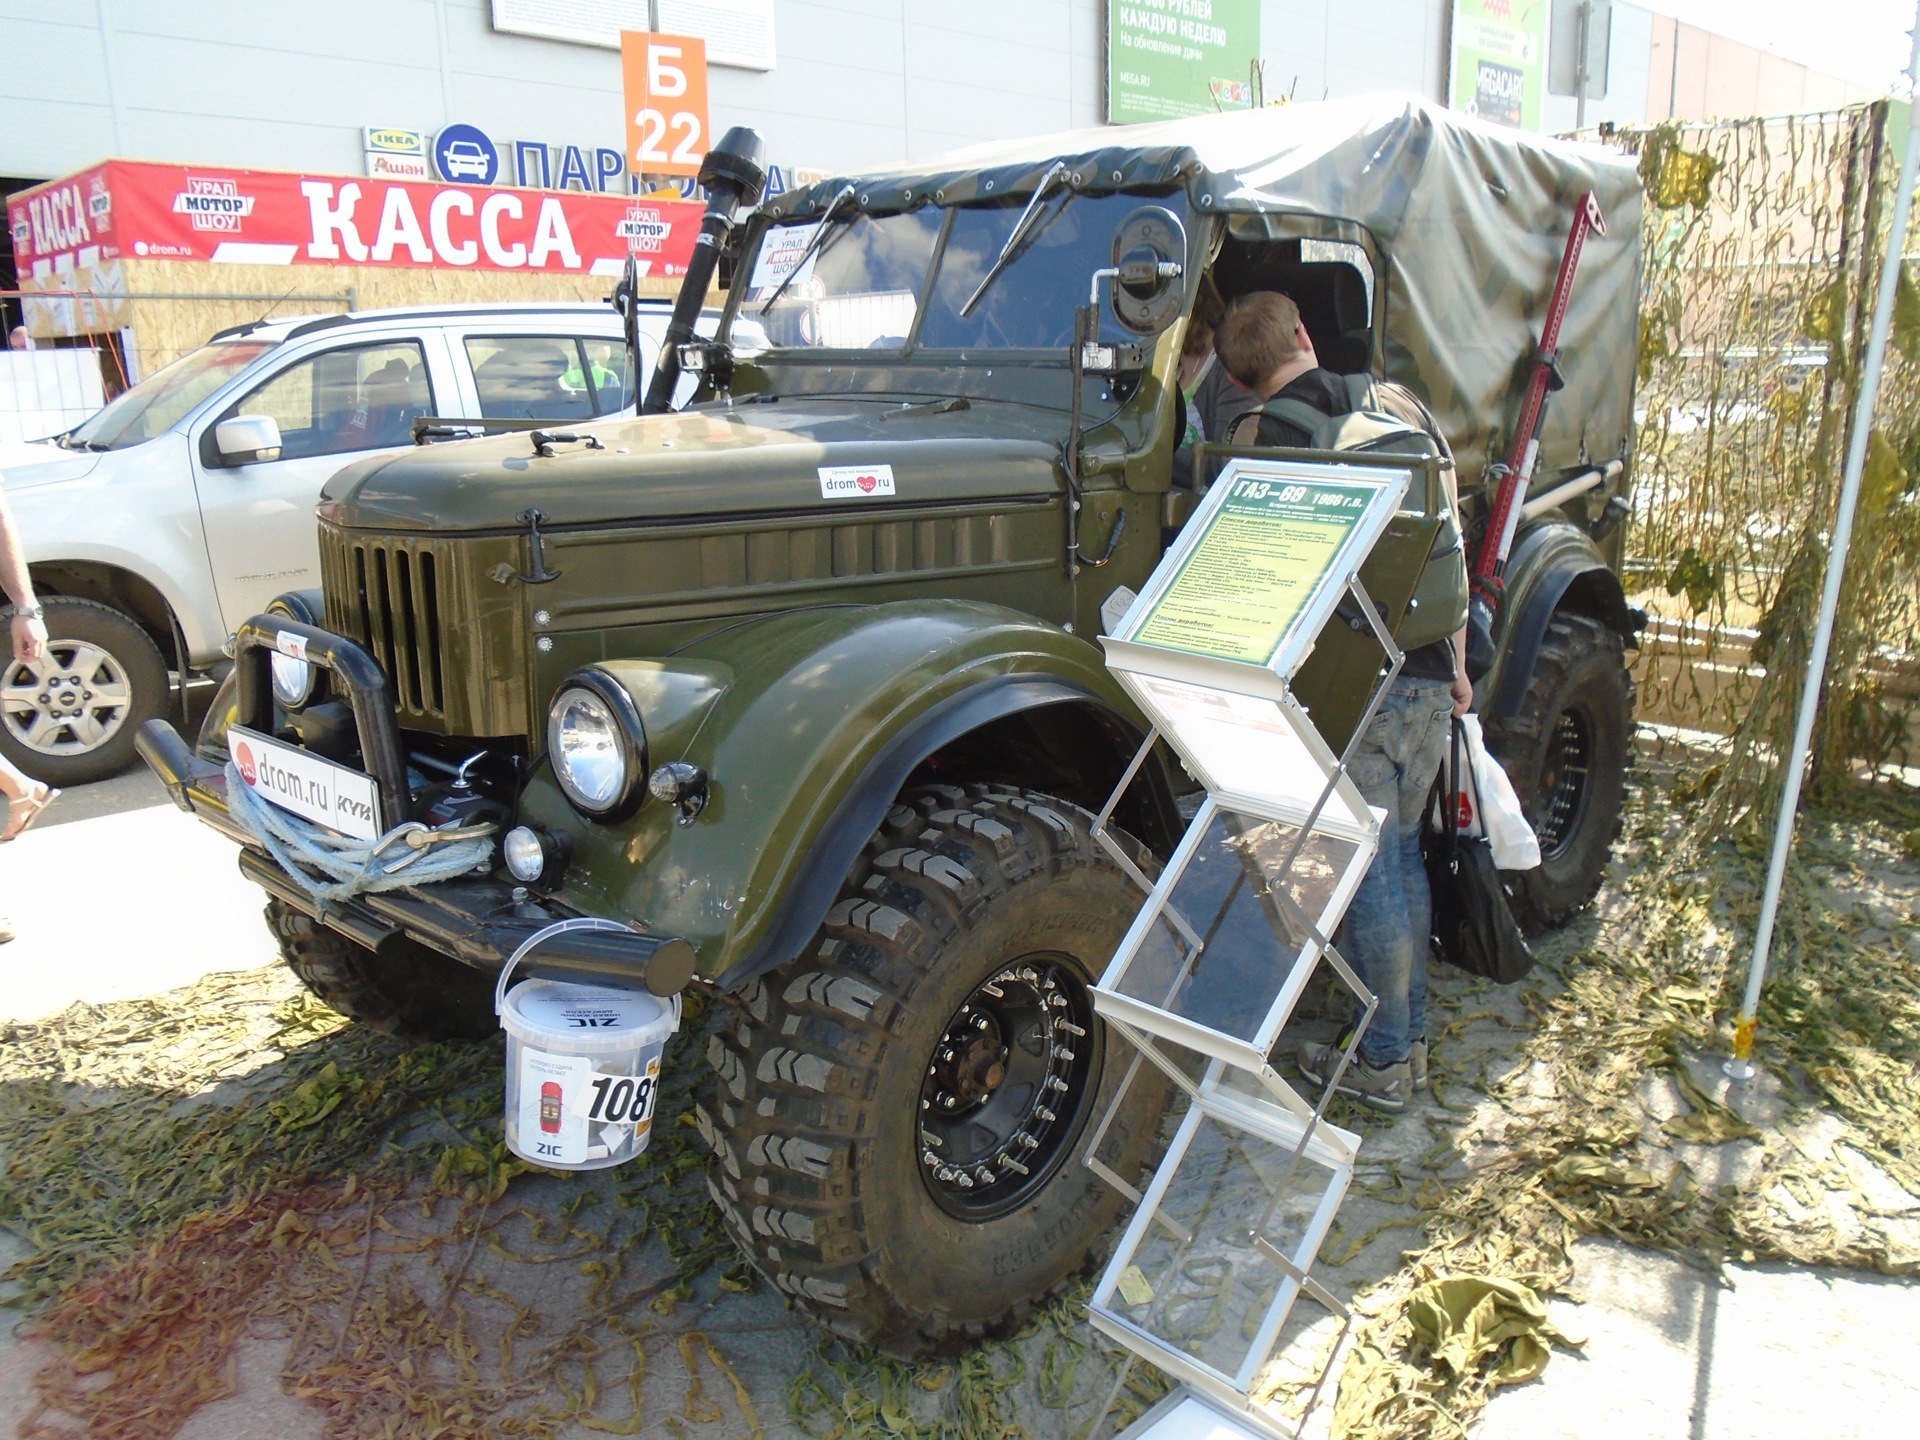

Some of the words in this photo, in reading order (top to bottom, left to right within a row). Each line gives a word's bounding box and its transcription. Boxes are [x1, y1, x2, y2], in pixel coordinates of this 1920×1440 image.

[1120, 6, 1178, 35] КАЖДУЮ
[1180, 20, 1227, 47] НЕДЕЛЮ
[1120, 31, 1132, 47] На
[1133, 34, 1182, 56] обновление
[1183, 49, 1203, 61] дачи
[647, 44, 688, 98] Б
[1120, 72, 1151, 87] MEGA.RU
[376, 133, 415, 146] IKEA
[634, 107, 703, 166] 22
[374, 156, 425, 176] Ашан
[190, 179, 235, 195] УРАЛ
[185, 196, 244, 213] МОТОР
[28, 184, 92, 255] КАССА
[194, 213, 238, 230] ШОУ
[628, 210, 658, 222] УРАЛ
[301, 181, 583, 269] КАССА
[623, 222, 664, 237] МОТОР
[149, 243, 193, 256] drom.ru
[630, 237, 659, 251] ШОУ
[780, 239, 803, 250] УРАЛ
[826, 478, 857, 490] drom
[878, 478, 890, 488] ru
[258, 752, 329, 812] drom.ru
[566, 1017, 622, 1028] ZIC
[588, 1077, 659, 1123] 1081
[536, 1142, 563, 1158] ZIC
